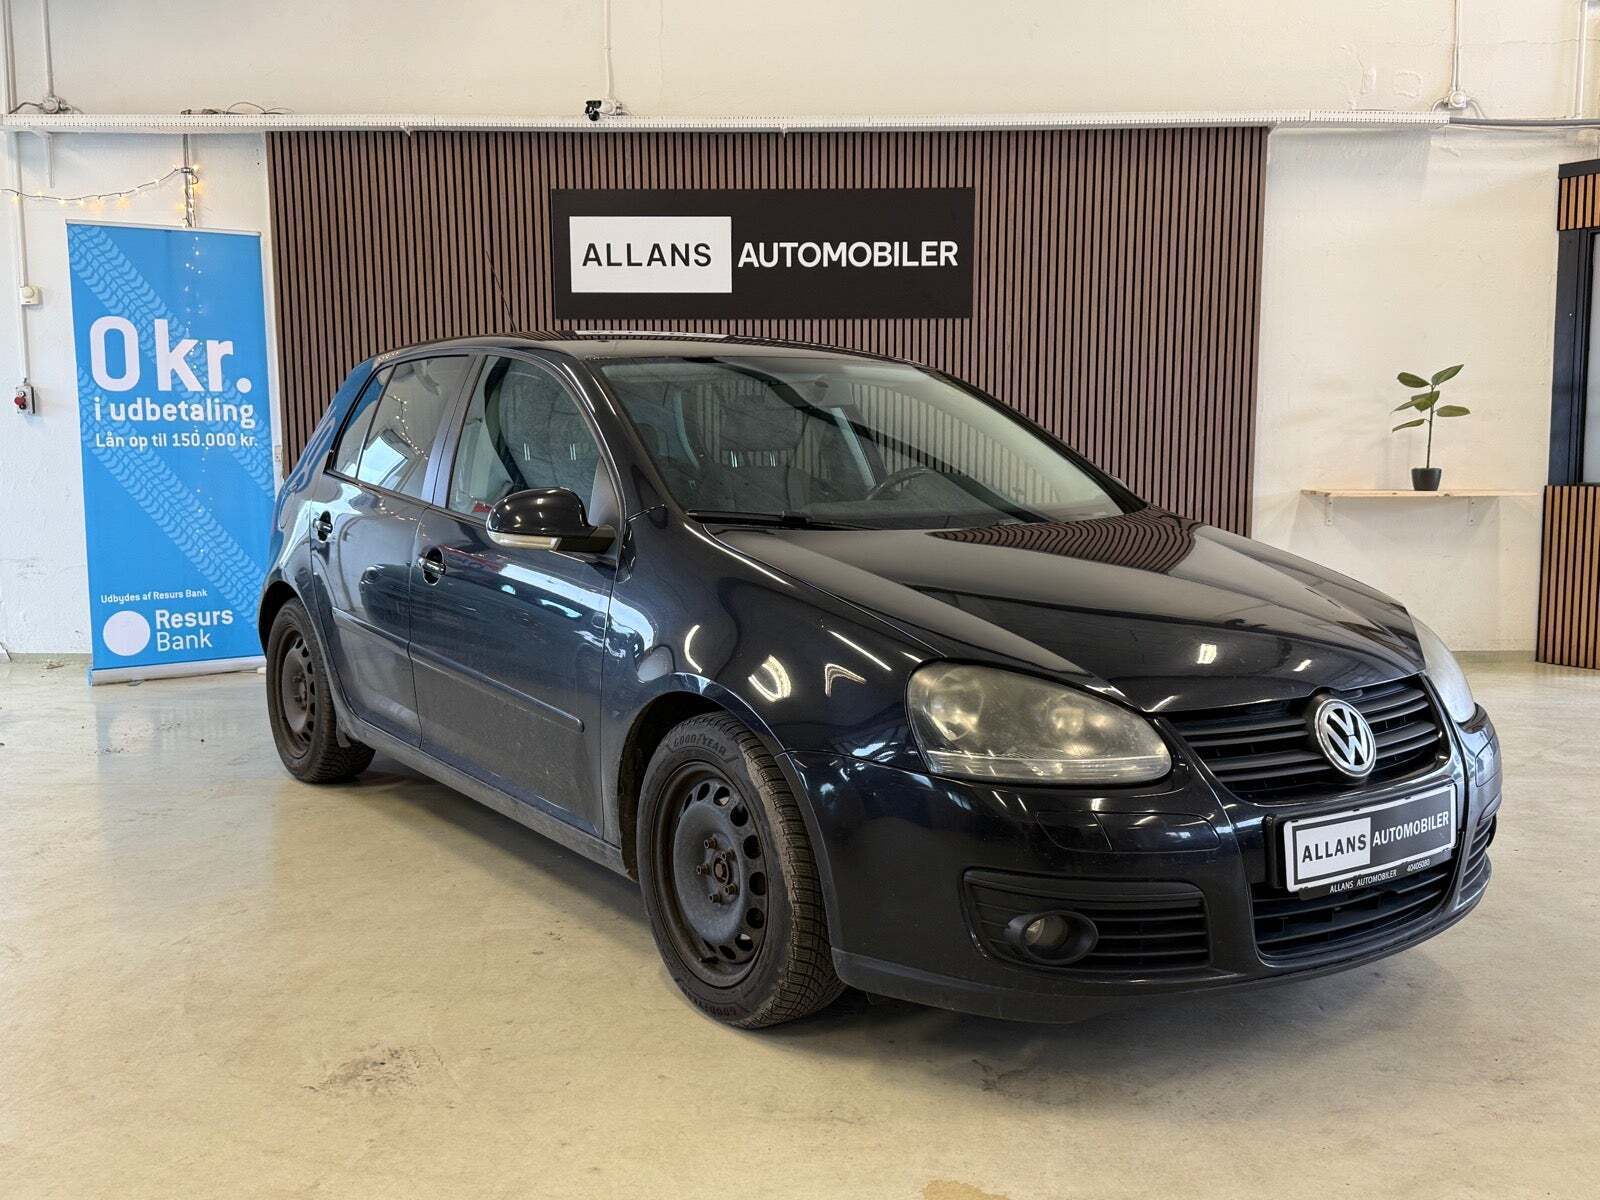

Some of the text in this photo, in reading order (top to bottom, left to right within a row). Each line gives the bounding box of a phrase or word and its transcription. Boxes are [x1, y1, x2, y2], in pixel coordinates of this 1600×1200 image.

[582, 240, 959, 269] ALLANS AUTOMOBILER
[89, 315, 252, 394] 0 kr.
[94, 396, 256, 429] i udbetaling
[95, 431, 258, 451] Lån op til 150.000 kr.
[100, 588, 208, 604] Udbydes af Resurs Bank
[155, 608, 233, 630] Resurs
[156, 628, 213, 652] Bank
[1302, 811, 1449, 863] ALLANS AUTOMOBILER
[1329, 880, 1354, 894] ALLANS
[1356, 869, 1397, 887] AUTOMOBILER
